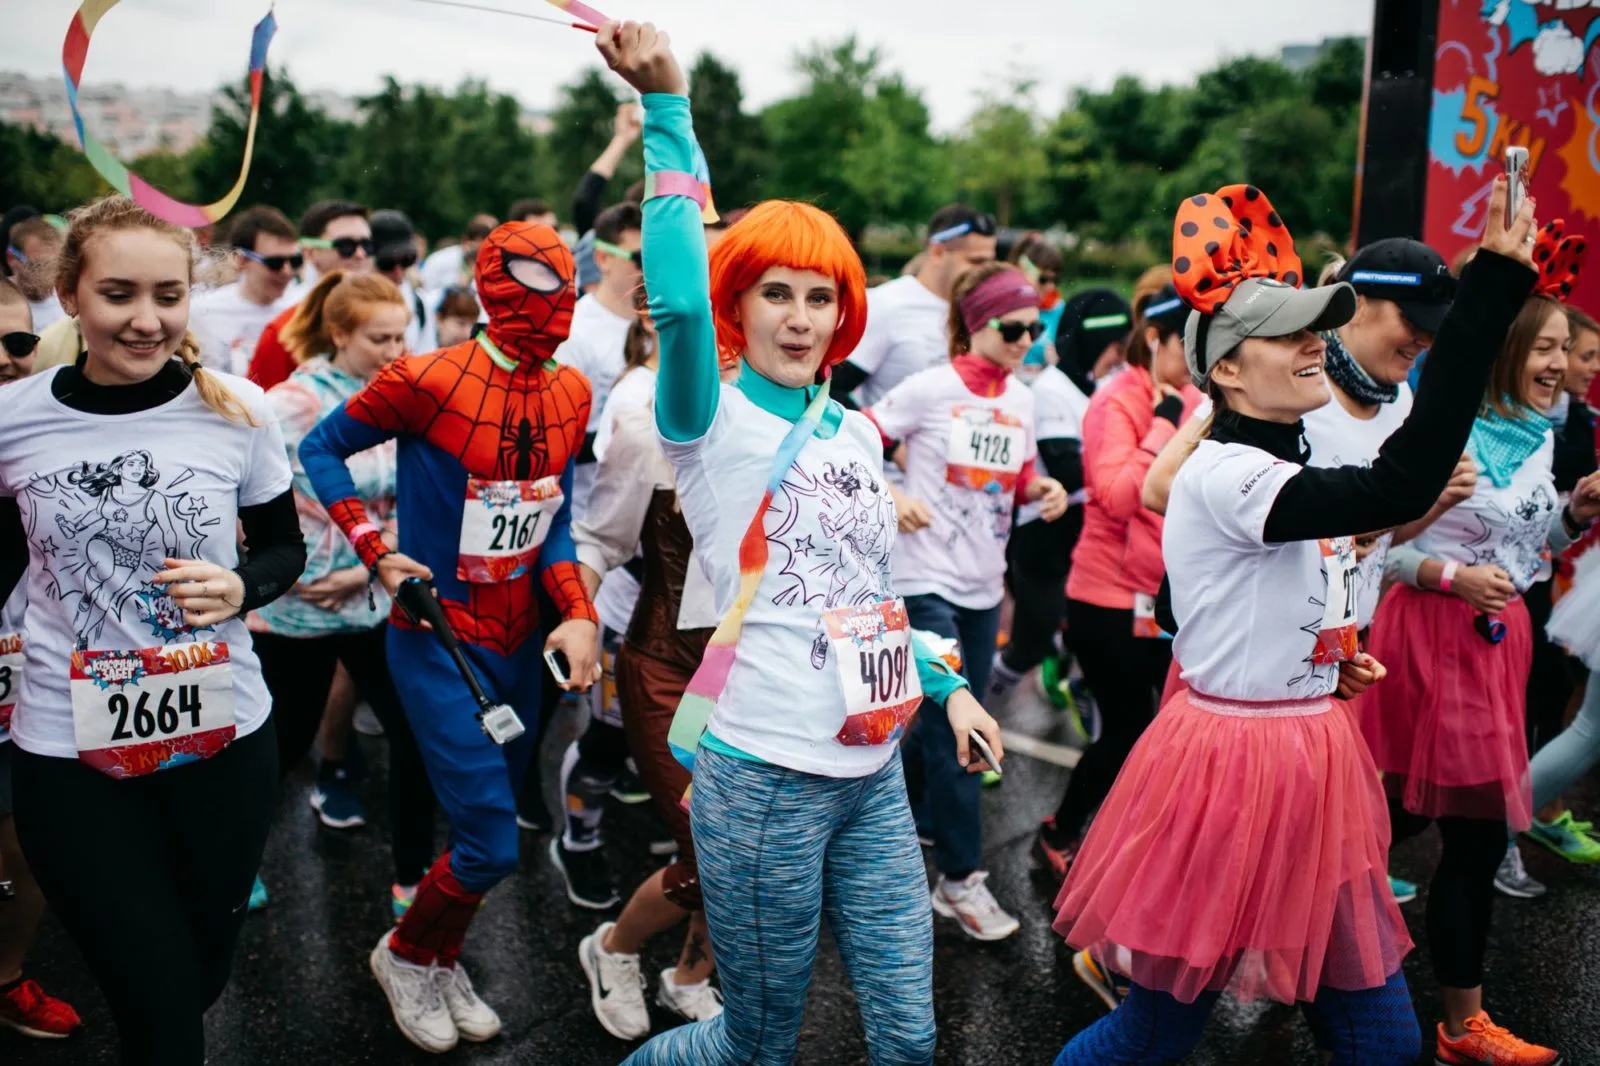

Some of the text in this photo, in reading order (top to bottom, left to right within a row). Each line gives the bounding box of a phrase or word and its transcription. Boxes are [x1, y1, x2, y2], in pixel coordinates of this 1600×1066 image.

[1455, 75, 1498, 157] 5
[488, 509, 543, 550] 2167
[166, 641, 212, 674] 10.06
[108, 684, 202, 741] 2664
